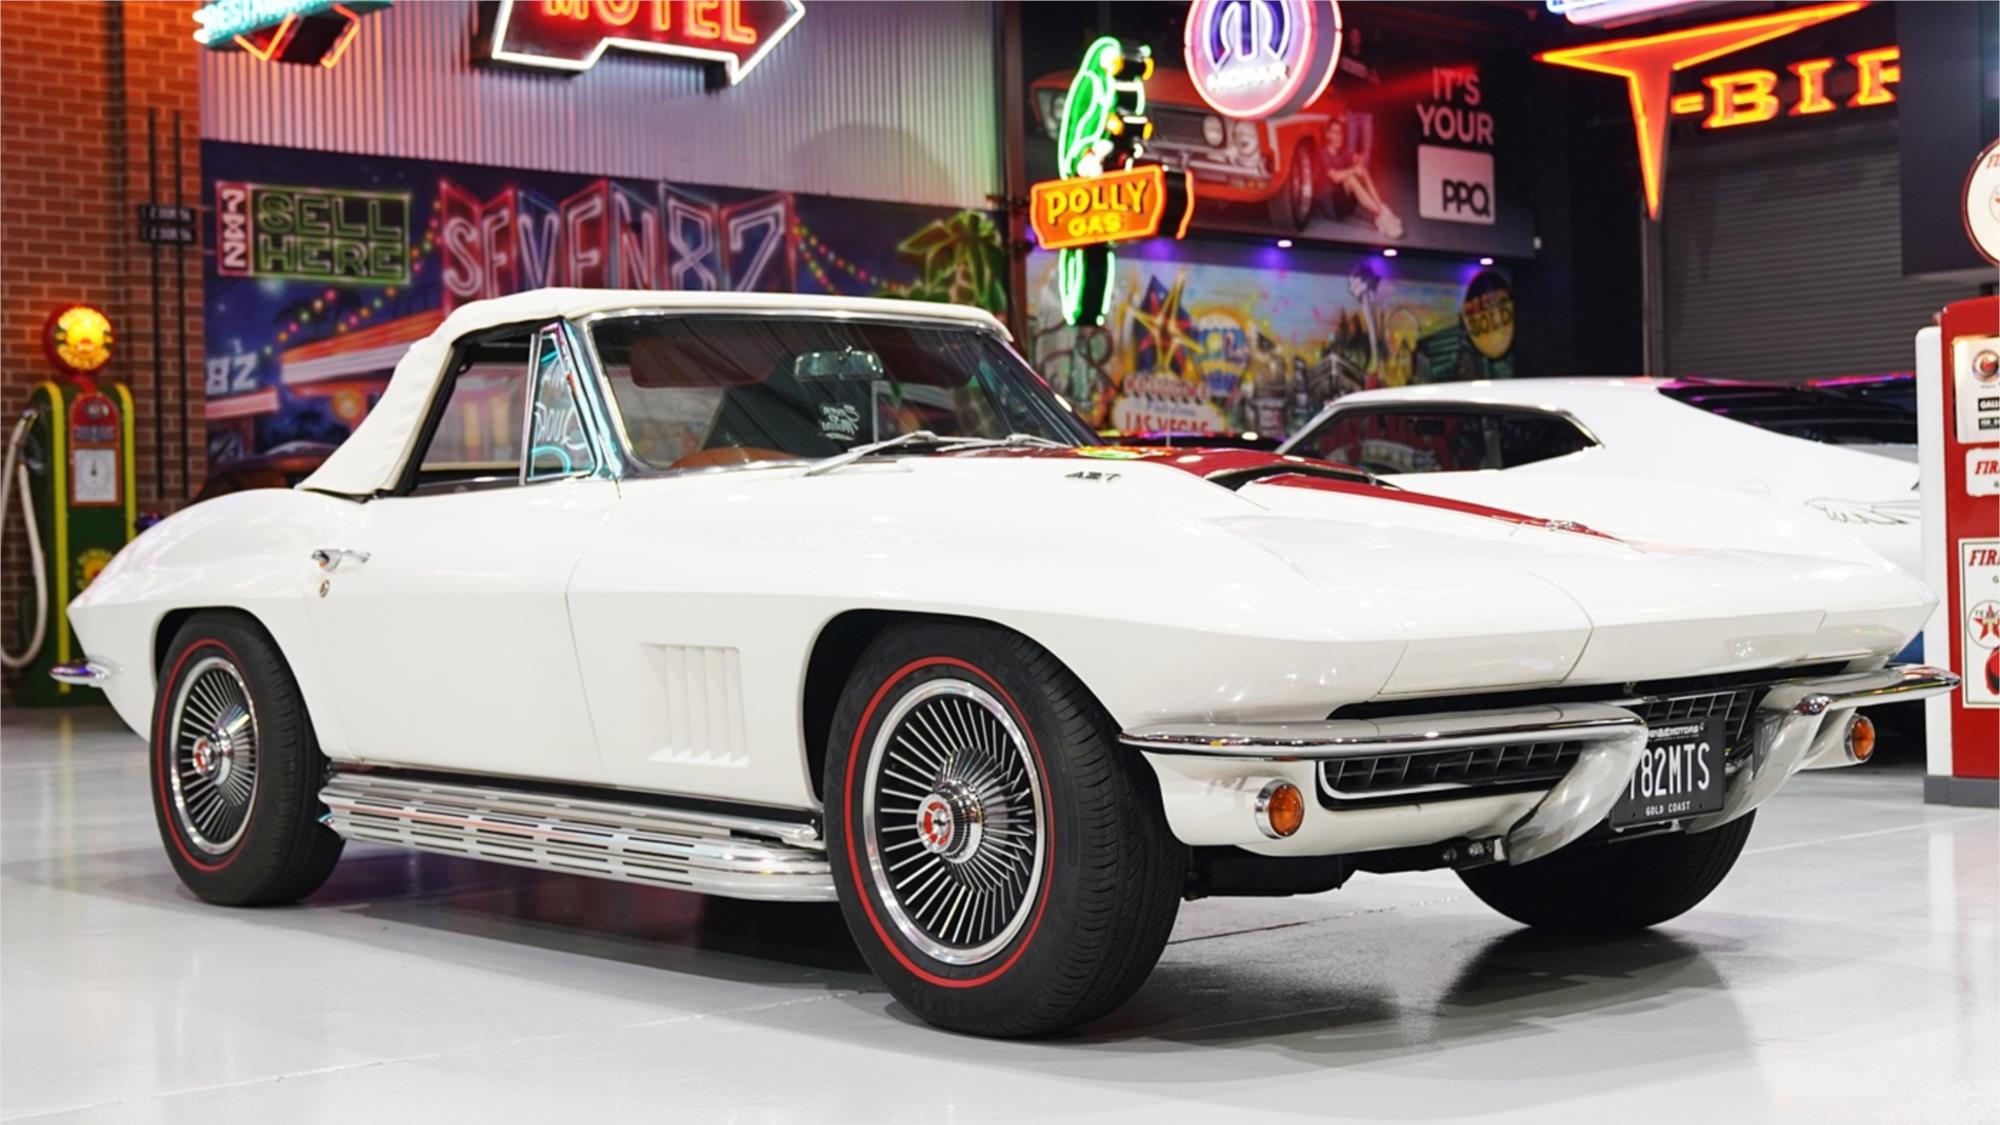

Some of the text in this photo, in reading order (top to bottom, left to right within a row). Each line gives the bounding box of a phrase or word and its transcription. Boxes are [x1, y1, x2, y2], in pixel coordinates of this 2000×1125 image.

[1432, 67, 1480, 105] IT'S
[1416, 104, 1494, 145] YOUR
[258, 191, 403, 240] SELL
[1045, 179, 1149, 224] POLLY
[1442, 179, 1490, 216] PPQ
[1068, 214, 1122, 238] GAS
[258, 234, 403, 276] HERE
[1064, 471, 1121, 482] 427
[1974, 460, 2000, 476] FIR
[1968, 549, 2000, 567] FIR
[1645, 801, 1691, 817] GOLD COAST
